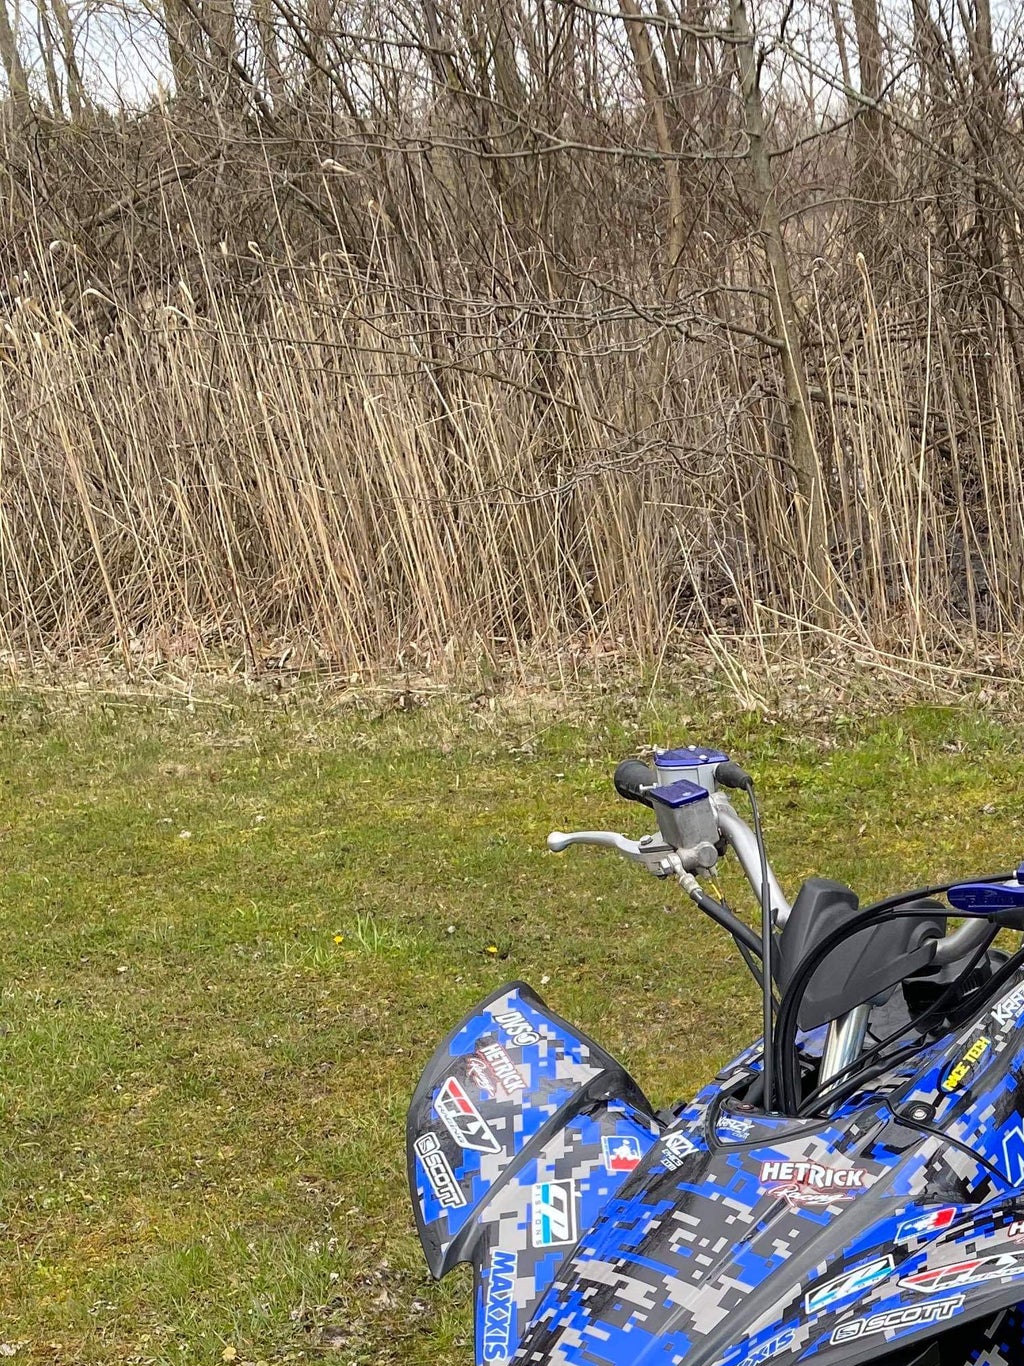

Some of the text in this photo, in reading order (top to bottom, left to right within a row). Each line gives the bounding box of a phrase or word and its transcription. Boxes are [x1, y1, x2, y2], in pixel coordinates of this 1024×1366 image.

[494, 1011, 532, 1037] DVS
[482, 1043, 527, 1094] HETRICK
[941, 1036, 992, 1091] RACE TECH
[424, 1152, 464, 1207] SCOTT
[761, 1162, 865, 1188] HETRICK
[483, 1250, 518, 1362] MAXXIS
[866, 1297, 963, 1331] SCOTT
